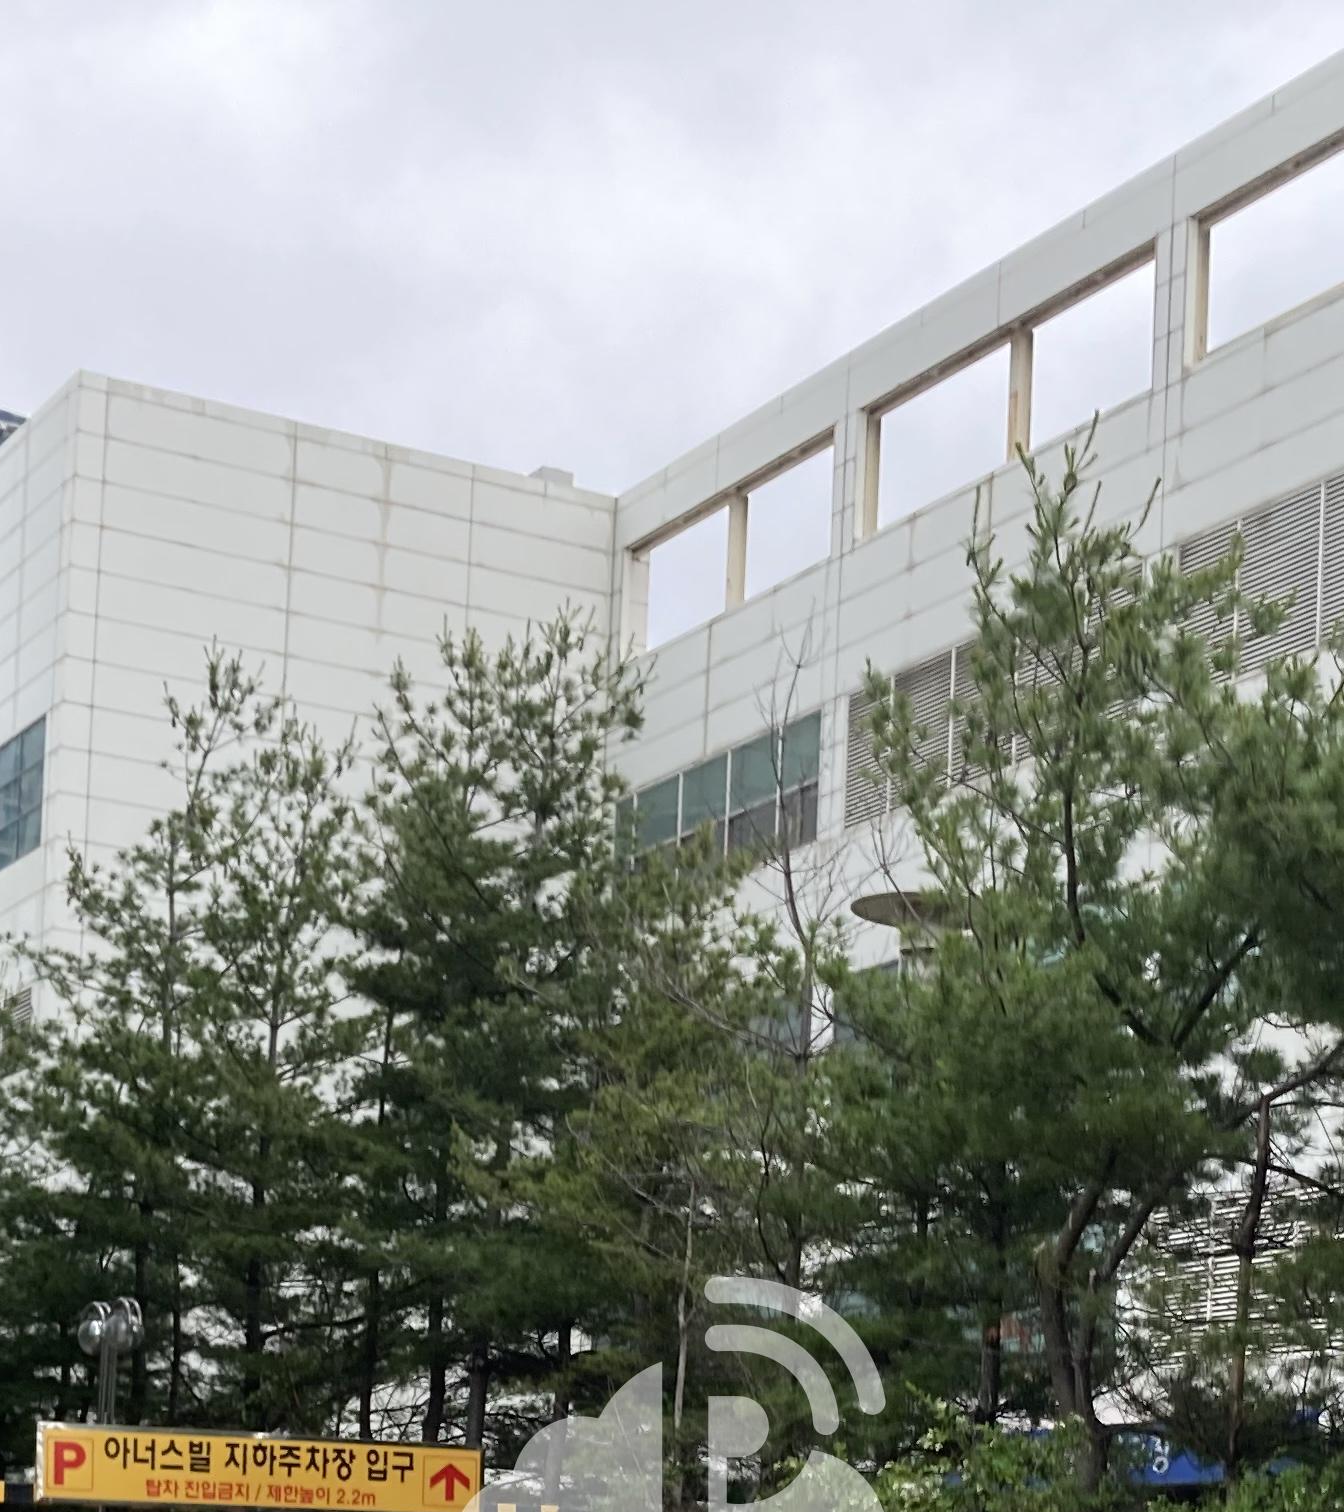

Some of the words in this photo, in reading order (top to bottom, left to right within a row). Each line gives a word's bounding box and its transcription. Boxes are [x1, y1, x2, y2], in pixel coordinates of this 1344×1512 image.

[53, 1441, 86, 1486] P
[104, 1437, 211, 1474] 아너스빌
[225, 1443, 356, 1482] 지하주차장
[367, 1450, 415, 1483] 입구
[185, 1480, 250, 1502] 진입금지
[266, 1484, 331, 1505] 제한높이
[336, 1490, 376, 1506] 2.2m
